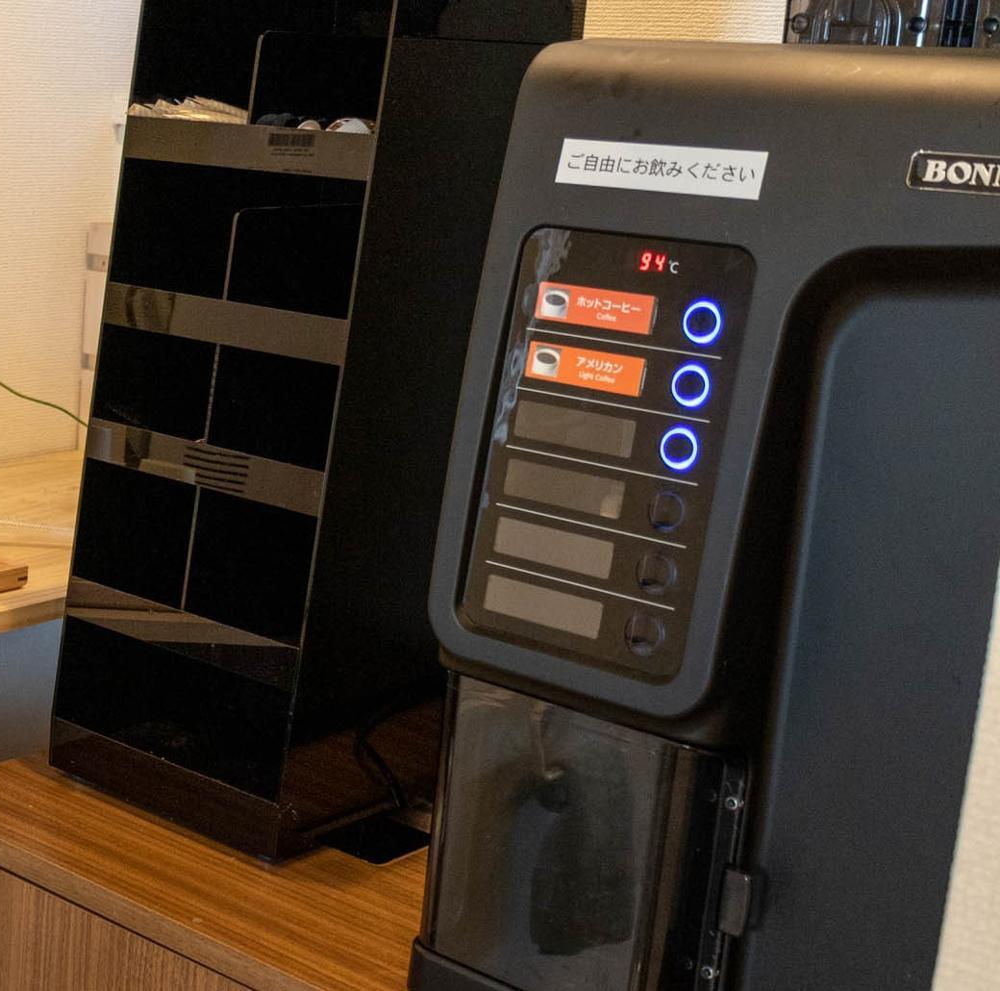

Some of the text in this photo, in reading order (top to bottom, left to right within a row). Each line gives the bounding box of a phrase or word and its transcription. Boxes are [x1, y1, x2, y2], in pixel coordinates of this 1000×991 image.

[567, 152, 755, 183] ご自由にお飲みください
[922, 159, 1000, 188] BON
[576, 295, 641, 314] ホットコーヒー
[596, 312, 617, 322] Coffee
[576, 356, 624, 374] アメリカン
[595, 374, 616, 384] Coffee
